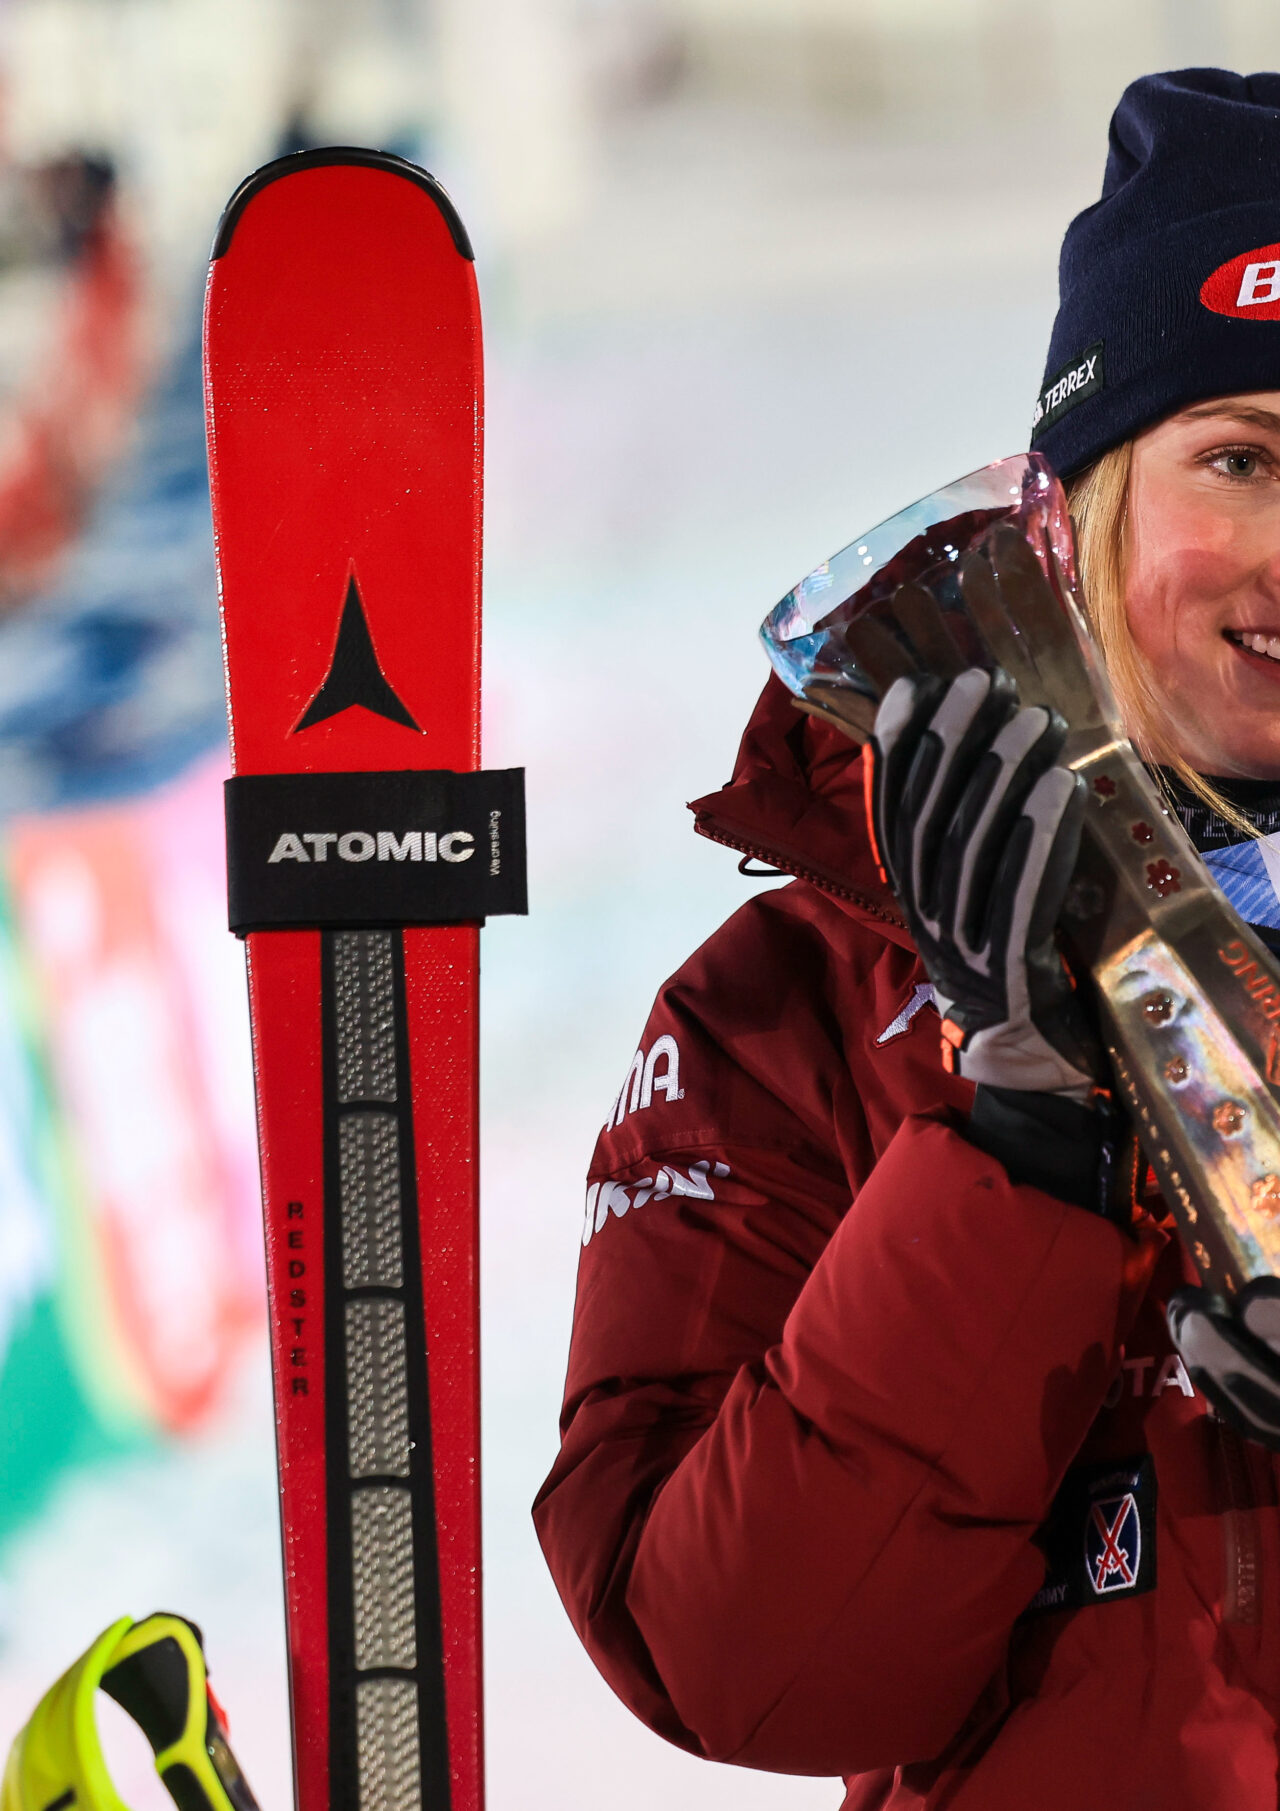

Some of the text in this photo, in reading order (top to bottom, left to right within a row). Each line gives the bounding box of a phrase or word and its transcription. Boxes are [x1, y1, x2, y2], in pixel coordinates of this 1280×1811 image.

[1044, 355, 1098, 414] TERREX
[267, 831, 476, 864] ATOMIC
[287, 1202, 309, 1397] REDSTER
